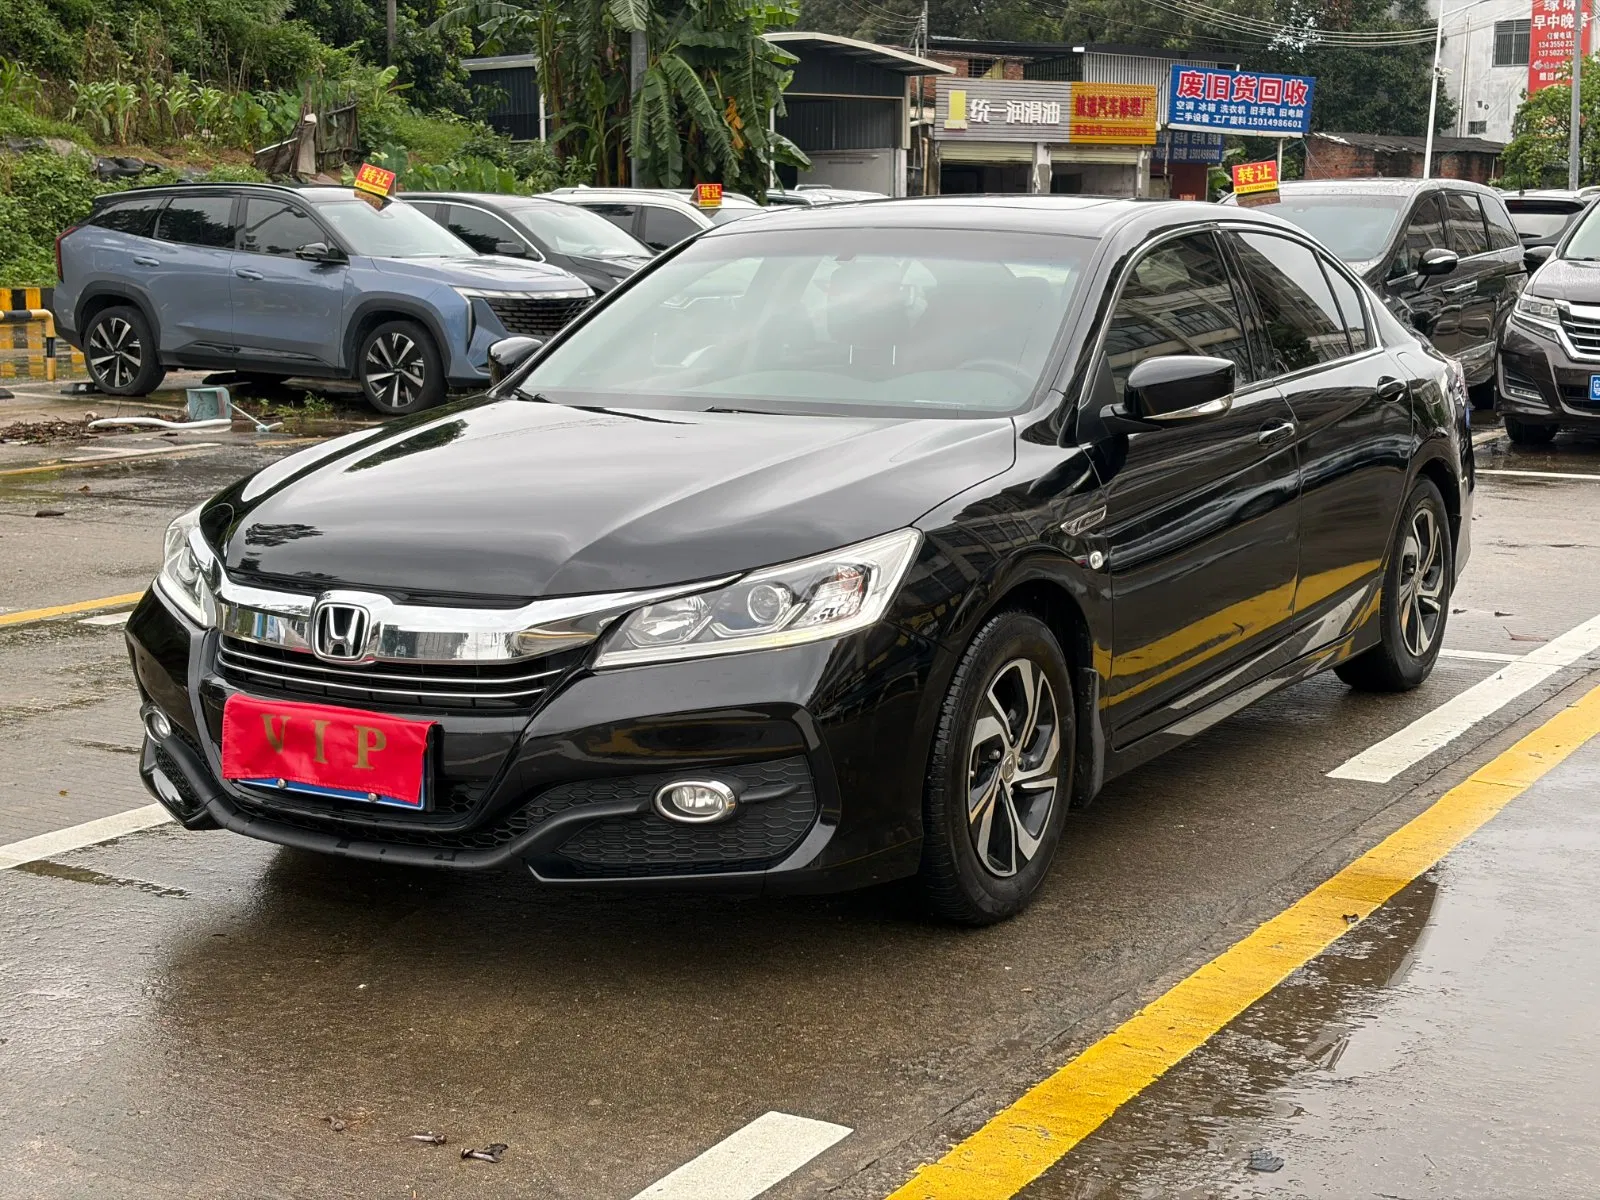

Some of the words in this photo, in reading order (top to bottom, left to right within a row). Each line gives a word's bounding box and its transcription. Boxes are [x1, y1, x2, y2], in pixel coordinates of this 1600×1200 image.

[1176, 70, 1309, 107] 废旧货回收
[969, 99, 1060, 124] 统一润滑油
[1176, 101, 1195, 111] 空调
[1198, 102, 1216, 113] 冰箱
[1220, 104, 1246, 115] 洗衣机
[1250, 106, 1276, 117] 旧手机
[1279, 108, 1304, 118] 旧电脑
[1175, 112, 1210, 123] 二手设备
[1213, 114, 1247, 125] 工厂废料
[1247, 118, 1302, 128] 15014986601
[362, 167, 390, 187] 转让
[1237, 164, 1273, 184] 转让
[700, 185, 720, 199] 转让
[260, 713, 387, 770] VIP
